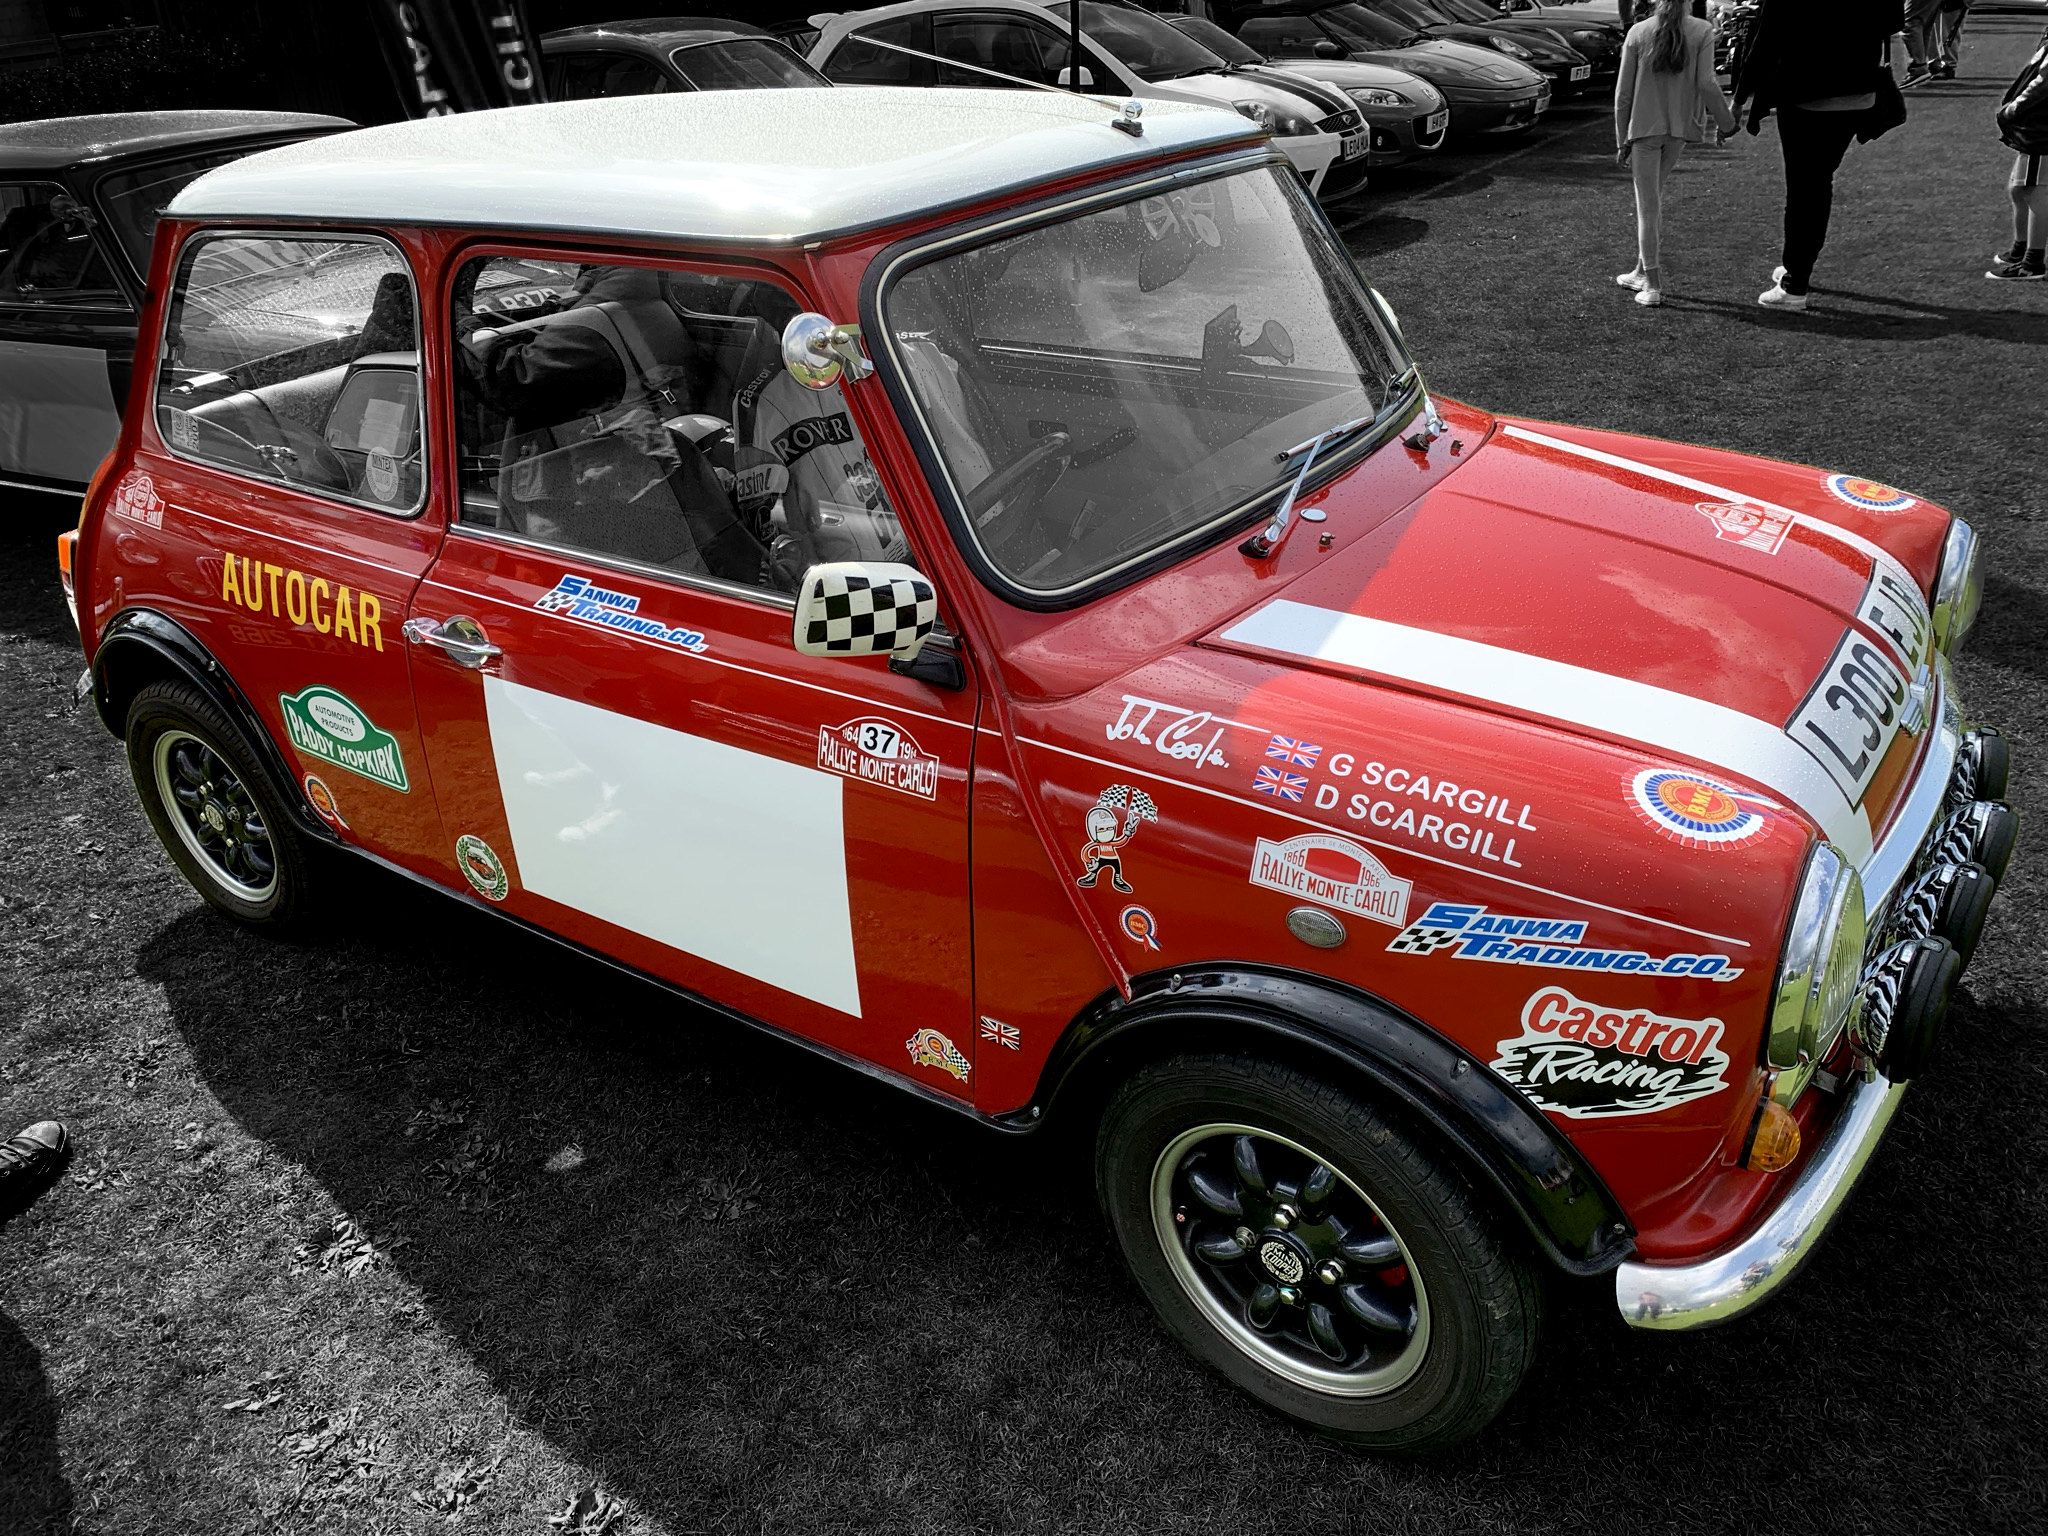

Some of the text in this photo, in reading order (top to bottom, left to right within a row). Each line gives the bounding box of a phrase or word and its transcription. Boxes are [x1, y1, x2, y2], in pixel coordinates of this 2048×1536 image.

[774, 418, 851, 462] ROVER
[222, 552, 384, 653] AUTOCAR
[556, 576, 639, 612] SANWA
[315, 704, 356, 726] AUTOMOTIVE
[320, 717, 355, 737] PRODUCTS
[1805, 642, 1905, 784] L300
[286, 703, 402, 784] PADDY HOPKIRK
[863, 726, 896, 754] 37
[820, 729, 935, 796] RALLYE MONTE CARLO
[1328, 753, 1537, 832] G SCARGILL
[1687, 785, 1715, 818] BMC
[1314, 784, 1523, 868] D SCARGILL
[1283, 849, 1306, 868] 1866
[1284, 838, 1327, 851] CENTENAIRE
[1259, 851, 1306, 891] RALLYE
[1359, 866, 1381, 888] 1966
[1416, 904, 1587, 940] SANWA
[1527, 992, 1721, 1066] Castrol
[1527, 1044, 1686, 1109] Racing
[1265, 1252, 1298, 1278] COOPER
[1272, 1248, 1296, 1267] MINI
